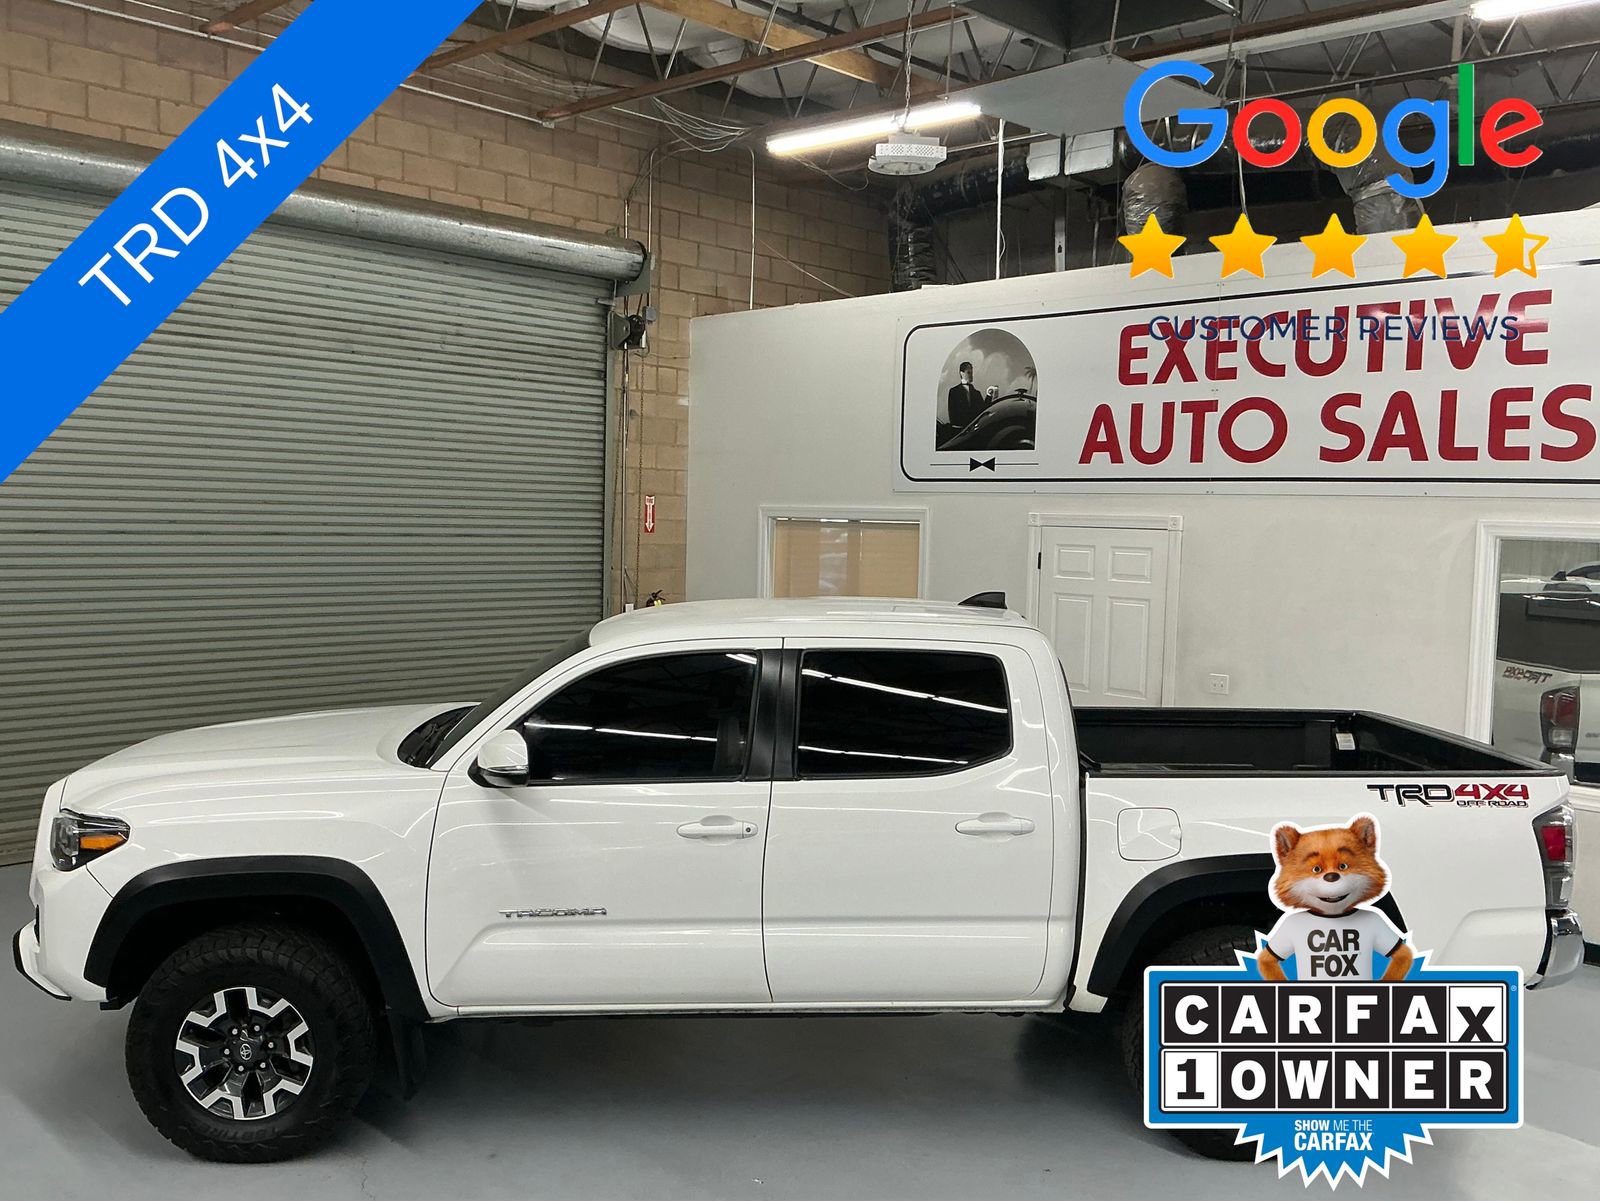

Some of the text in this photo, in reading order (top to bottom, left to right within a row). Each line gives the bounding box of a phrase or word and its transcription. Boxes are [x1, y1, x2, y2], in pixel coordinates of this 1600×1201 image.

[1118, 289, 1553, 386] EXECUTIVE
[1078, 384, 1598, 465] AUTO SALES
[1456, 800, 1529, 808] OFF ROAD
[499, 907, 607, 918] TACOMA
